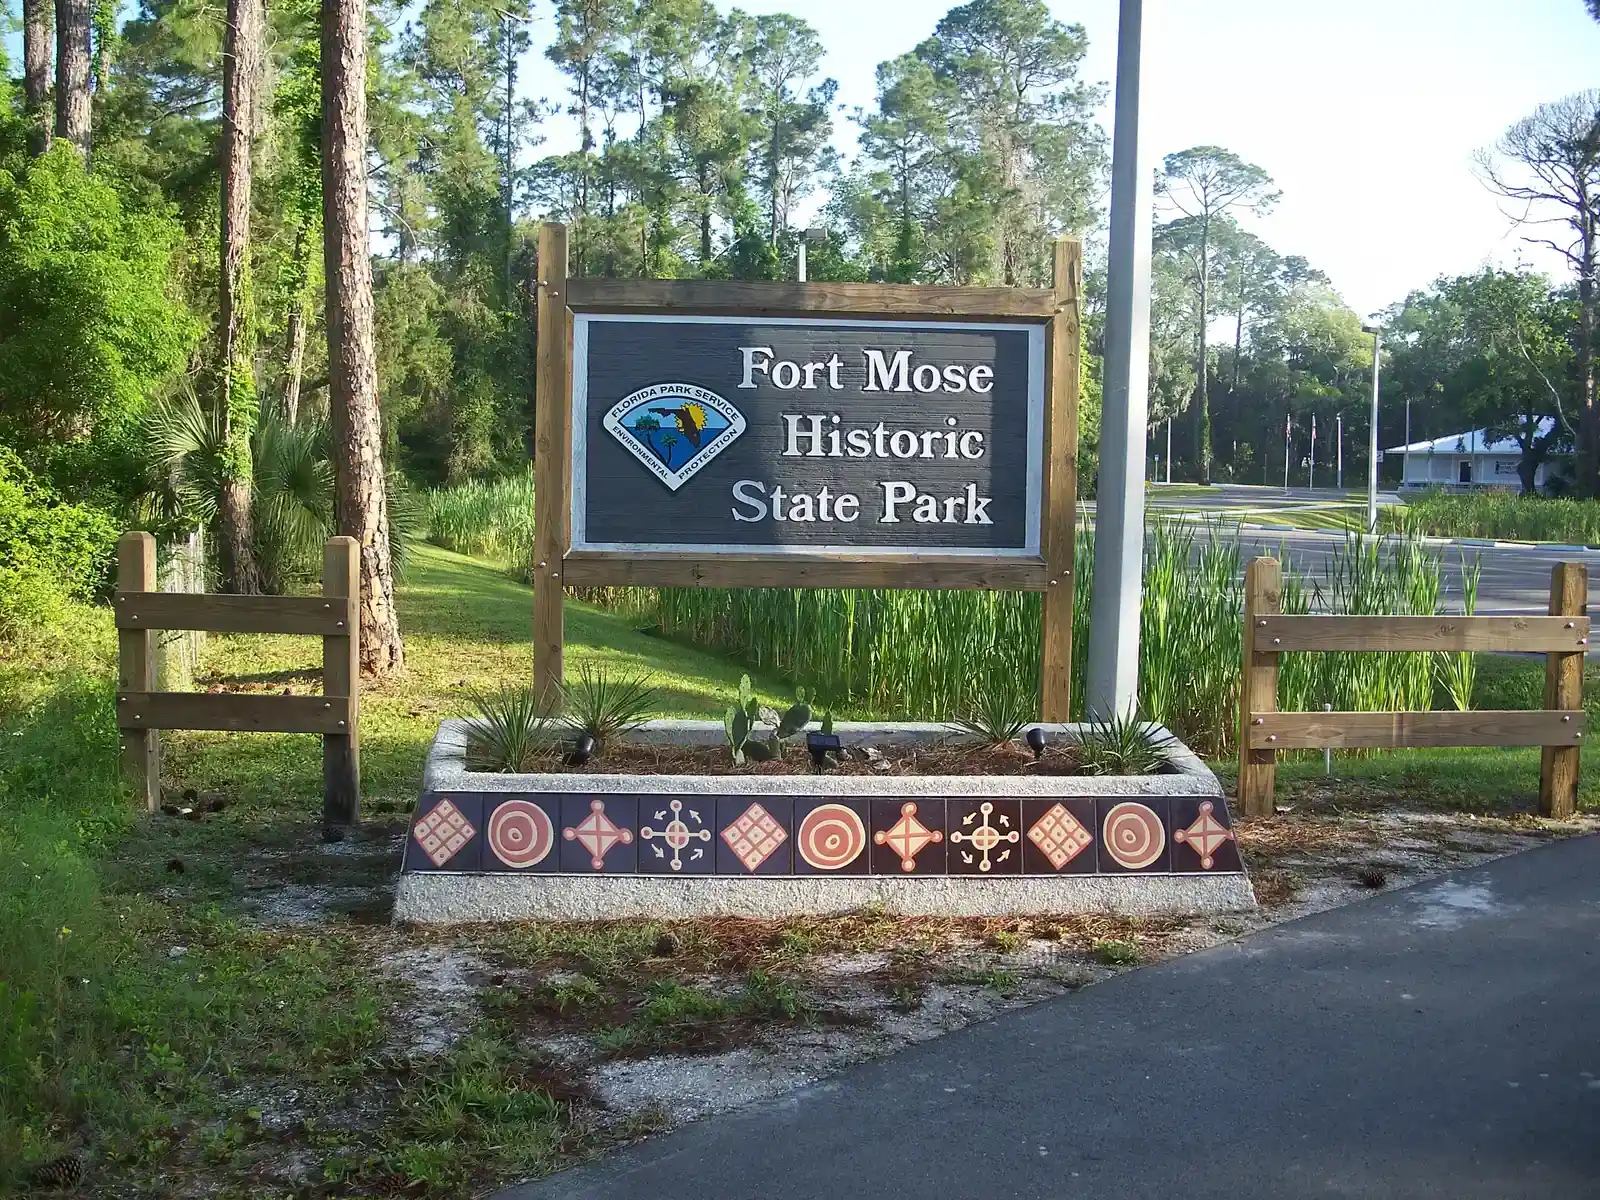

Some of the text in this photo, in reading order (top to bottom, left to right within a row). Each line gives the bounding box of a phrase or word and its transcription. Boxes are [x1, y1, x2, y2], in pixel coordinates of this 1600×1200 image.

[737, 346, 995, 393] Fort Mose
[611, 385, 740, 422] FLORIDA PARK SERVICE
[612, 425, 738, 480] ENVIRONMENTAL PROTECTION
[782, 414, 986, 459] Historic
[731, 479, 995, 525] State Park
